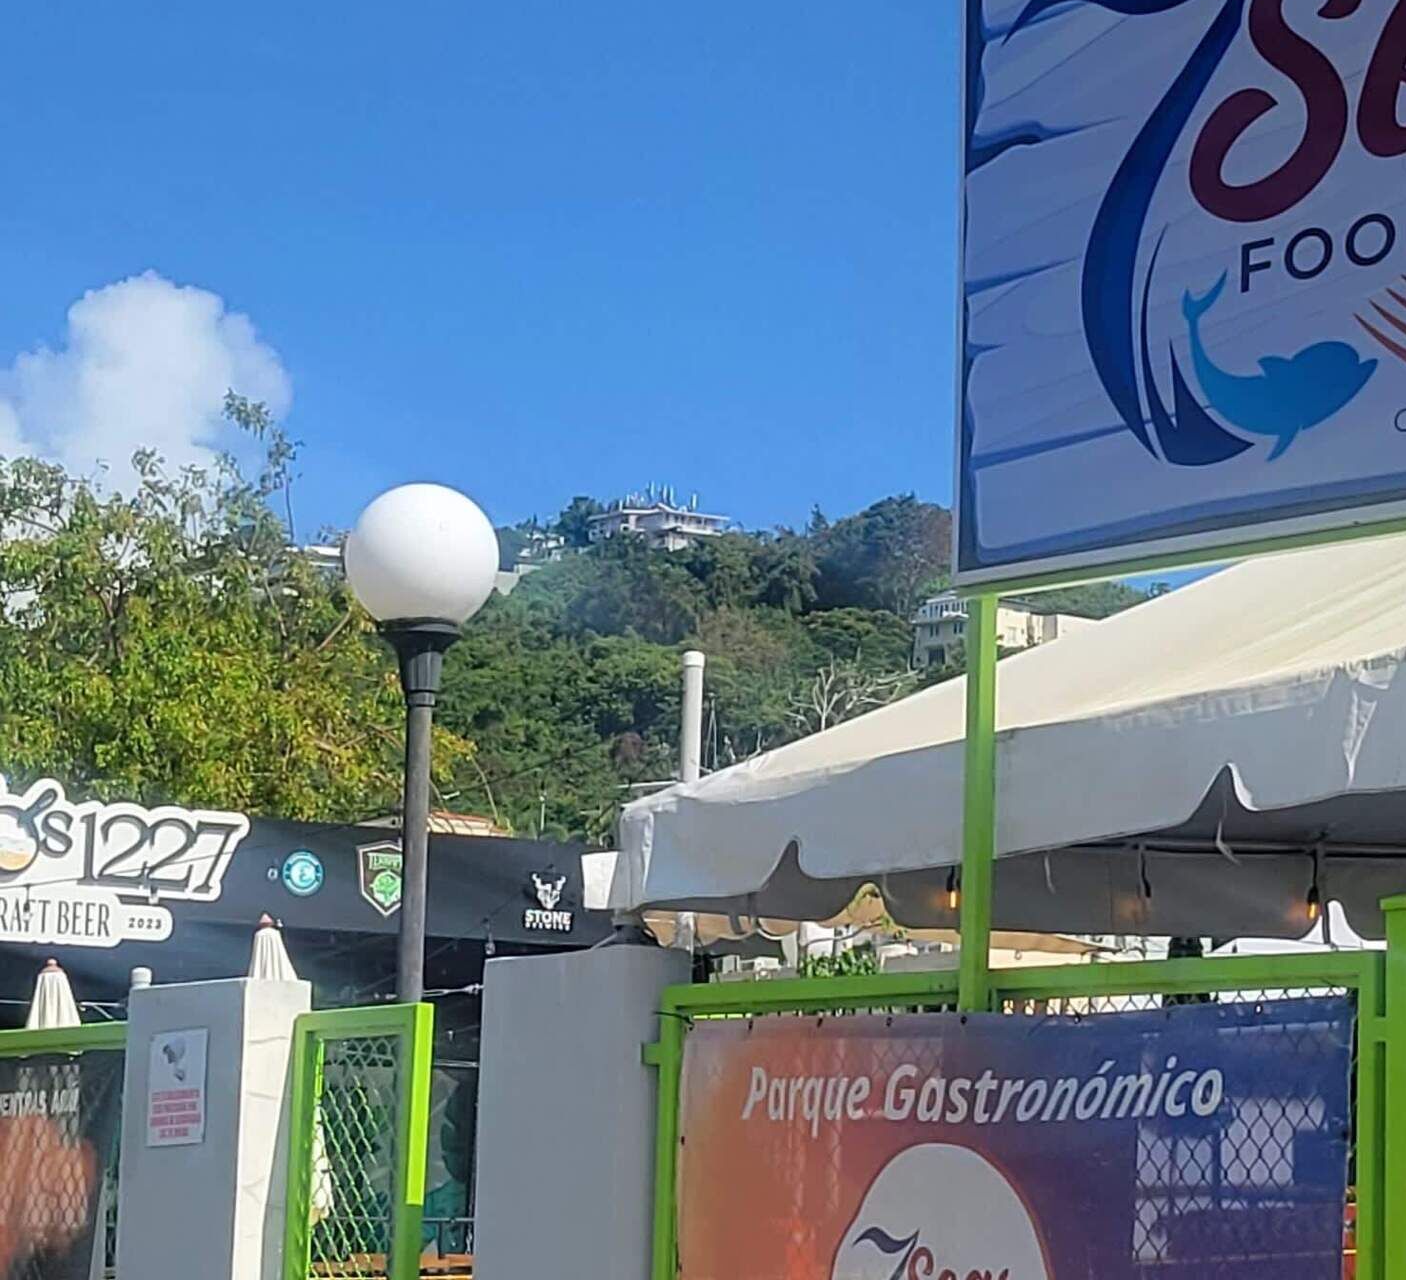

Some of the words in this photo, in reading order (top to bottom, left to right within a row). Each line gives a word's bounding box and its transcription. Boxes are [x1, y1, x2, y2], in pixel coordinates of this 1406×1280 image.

[57, 900, 110, 937] BEER
[128, 917, 162, 930] 2023
[524, 909, 572, 925] STONE
[741, 1065, 868, 1138] Parque
[881, 1053, 1223, 1123] Gastronómico
